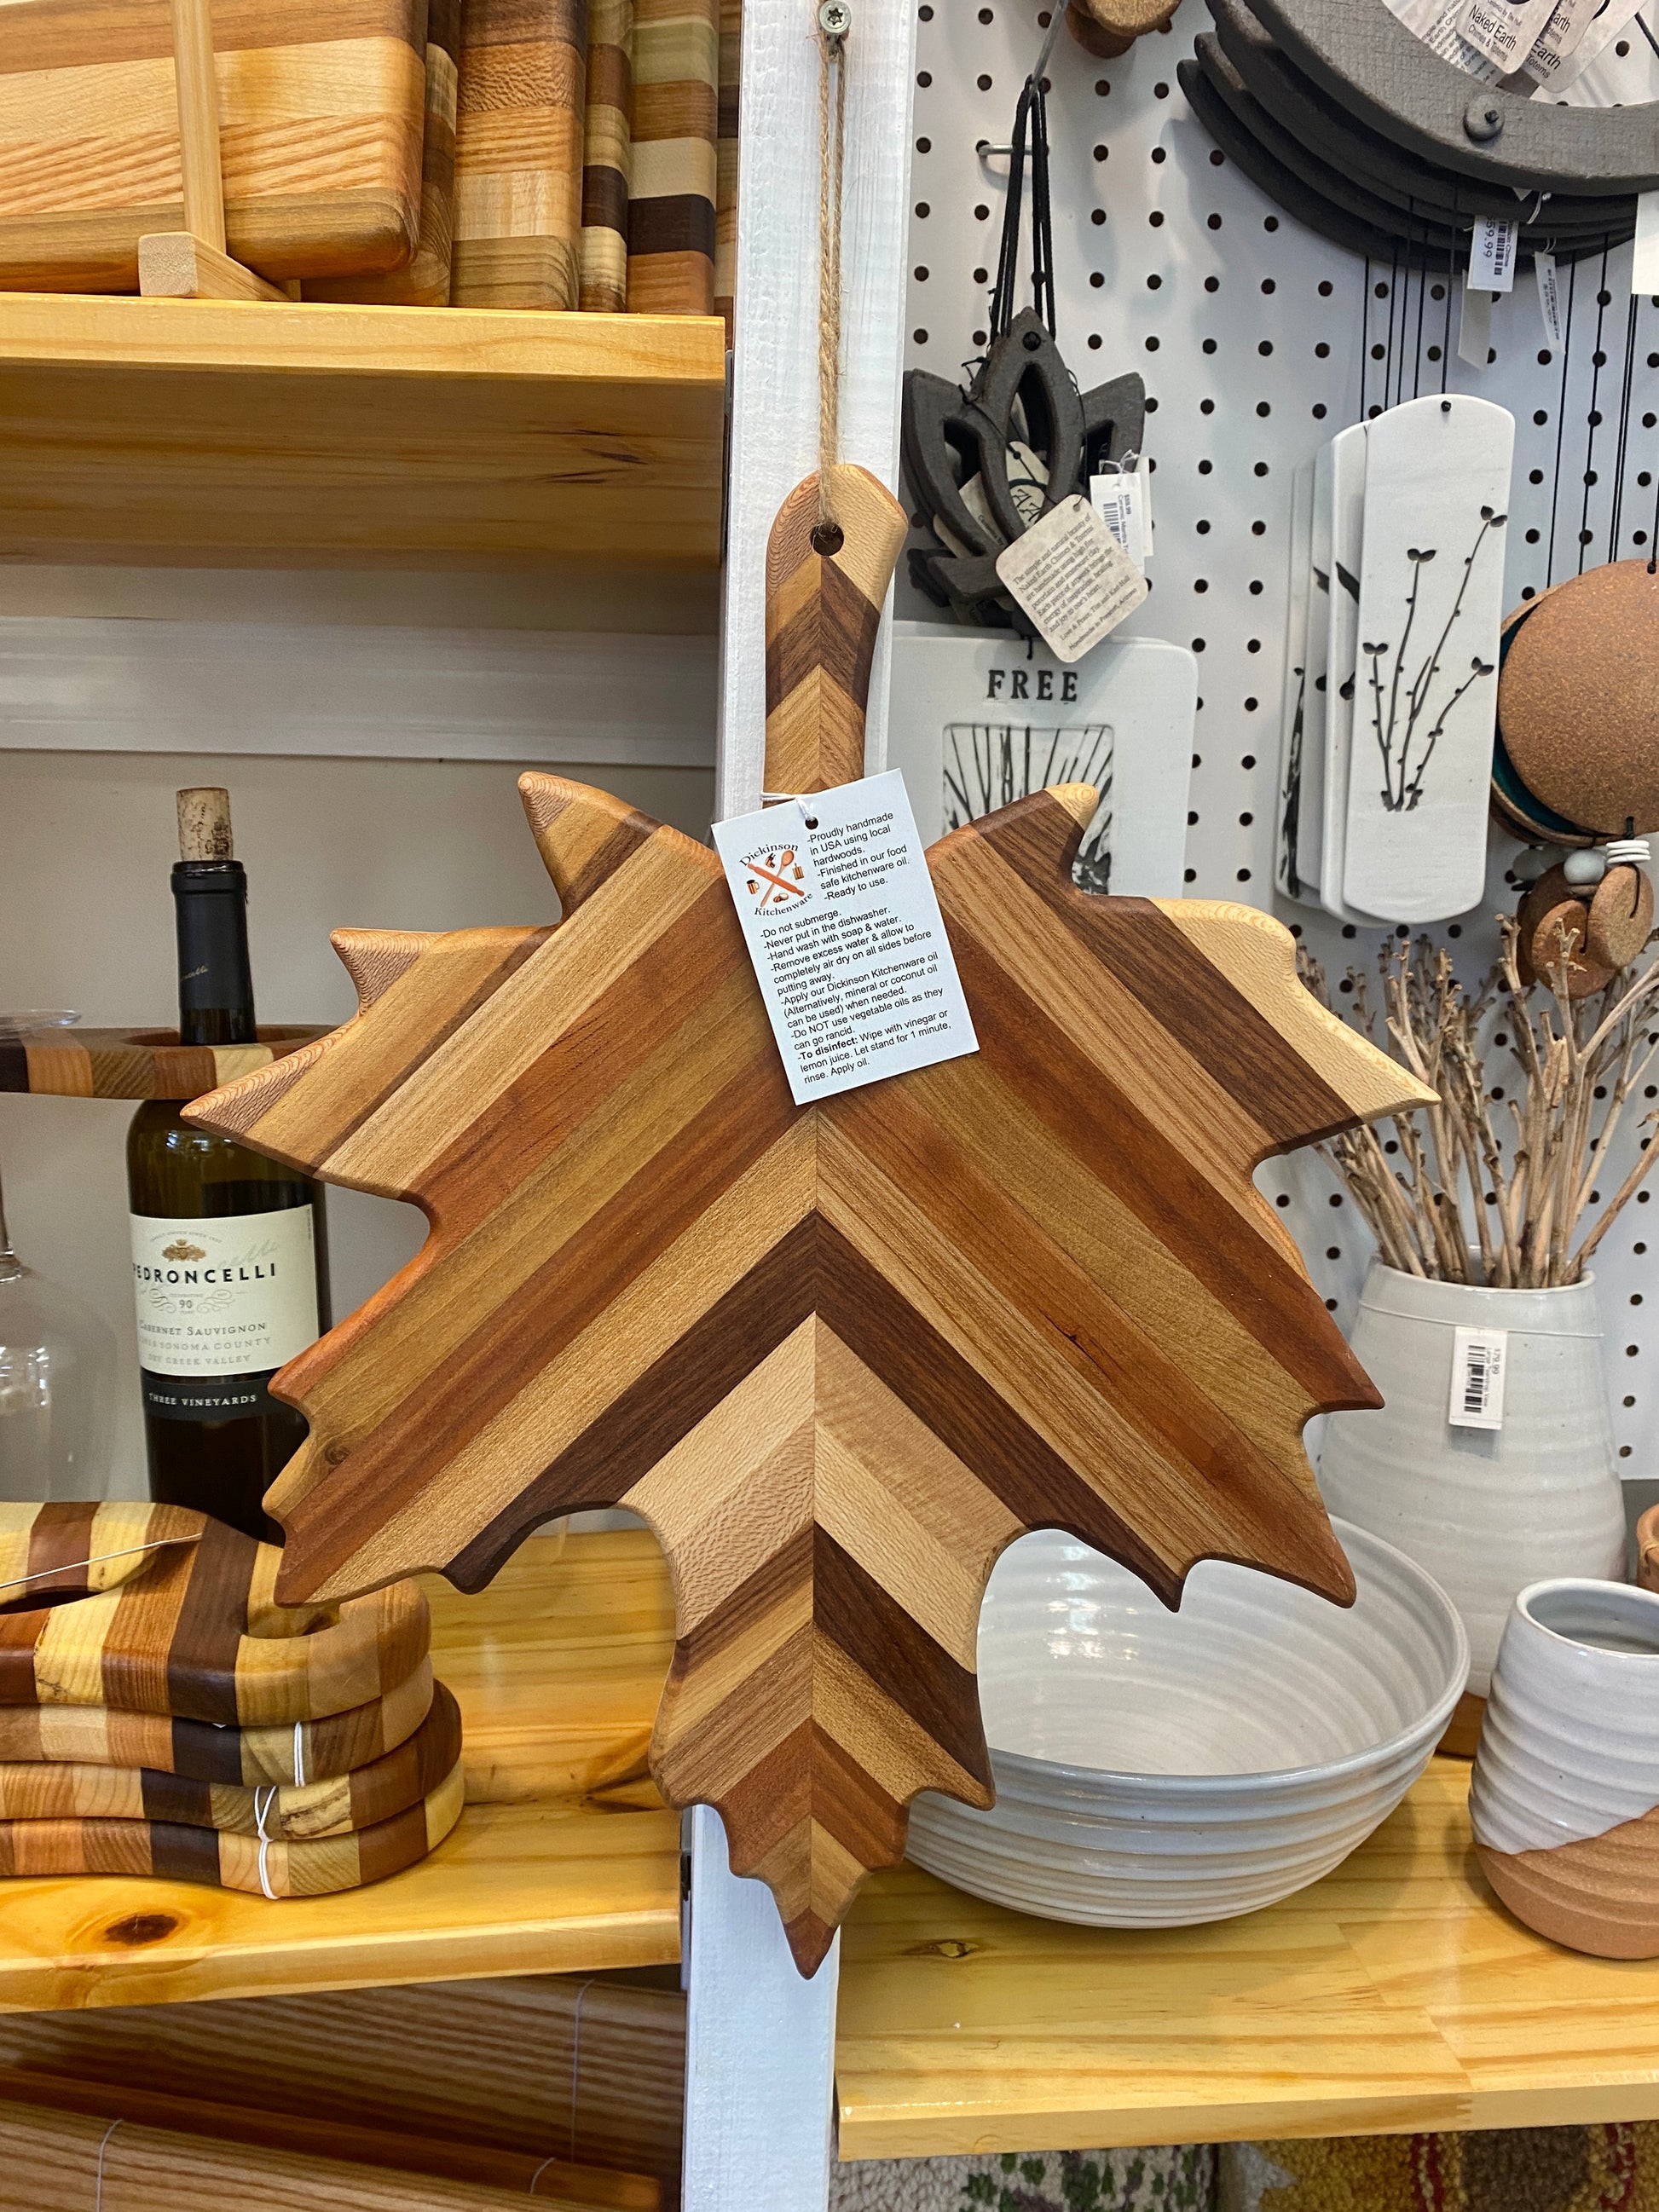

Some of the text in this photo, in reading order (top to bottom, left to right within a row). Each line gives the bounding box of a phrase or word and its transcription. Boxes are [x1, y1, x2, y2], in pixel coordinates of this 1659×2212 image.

[1468, 4, 1497, 33] Naked
[1494, 25, 1517, 51] Earth
[1553, 13, 1571, 34] arth
[1526, 54, 1551, 78] Totems
[1531, 38, 1561, 70] Earth
[1013, 575, 1025, 584] The
[986, 669, 1078, 702] FREE
[806, 811, 893, 843] -Proudly handmade
[809, 823, 890, 855] in USA using local
[739, 843, 799, 866] Dickinson
[812, 846, 864, 867] hardwoods.
[817, 843, 907, 877] -Finished in our food
[820, 856, 910, 889] safe kitchenware oil.
[824, 877, 887, 900] -Ready to use.
[754, 893, 813, 916] Kitchenware
[760, 910, 841, 938] -Do not submerge.
[763, 935, 793, 949] -Never
[795, 929, 810, 942] put
[821, 922, 835, 933] the
[837, 906, 890, 927] dishwasher.
[766, 915, 901, 961] -Hand wash with soap & water.
[770, 923, 914, 972] -Remove excess water & allow to
[773, 931, 931, 984] completely air dry on all sides before
[777, 973, 835, 997] putting away.
[780, 950, 938, 1005] -Apply our Dickinson Kitchenware oil
[783, 963, 937, 1019] (Alternatively, mineral or coconut oil
[787, 985, 906, 1028] can be used) when needed.
[790, 987, 942, 1038] -Do NOT use vegetable oils as they
[794, 1025, 855, 1050] can go rancid.
[797, 1009, 947, 1060] -To disinfect: Wipe with vinegar or
[800, 1022, 951, 1072] lemon juice. Let stand for 1 minute,
[804, 1057, 870, 1083] rinse. Apply oil.
[179, 1299, 193, 1309] 90
[187, 1322, 266, 1337] SAUVIGNON
[213, 1337, 271, 1351] COUNTY
[148, 1393, 257, 1406] THREE VINEYARDS
